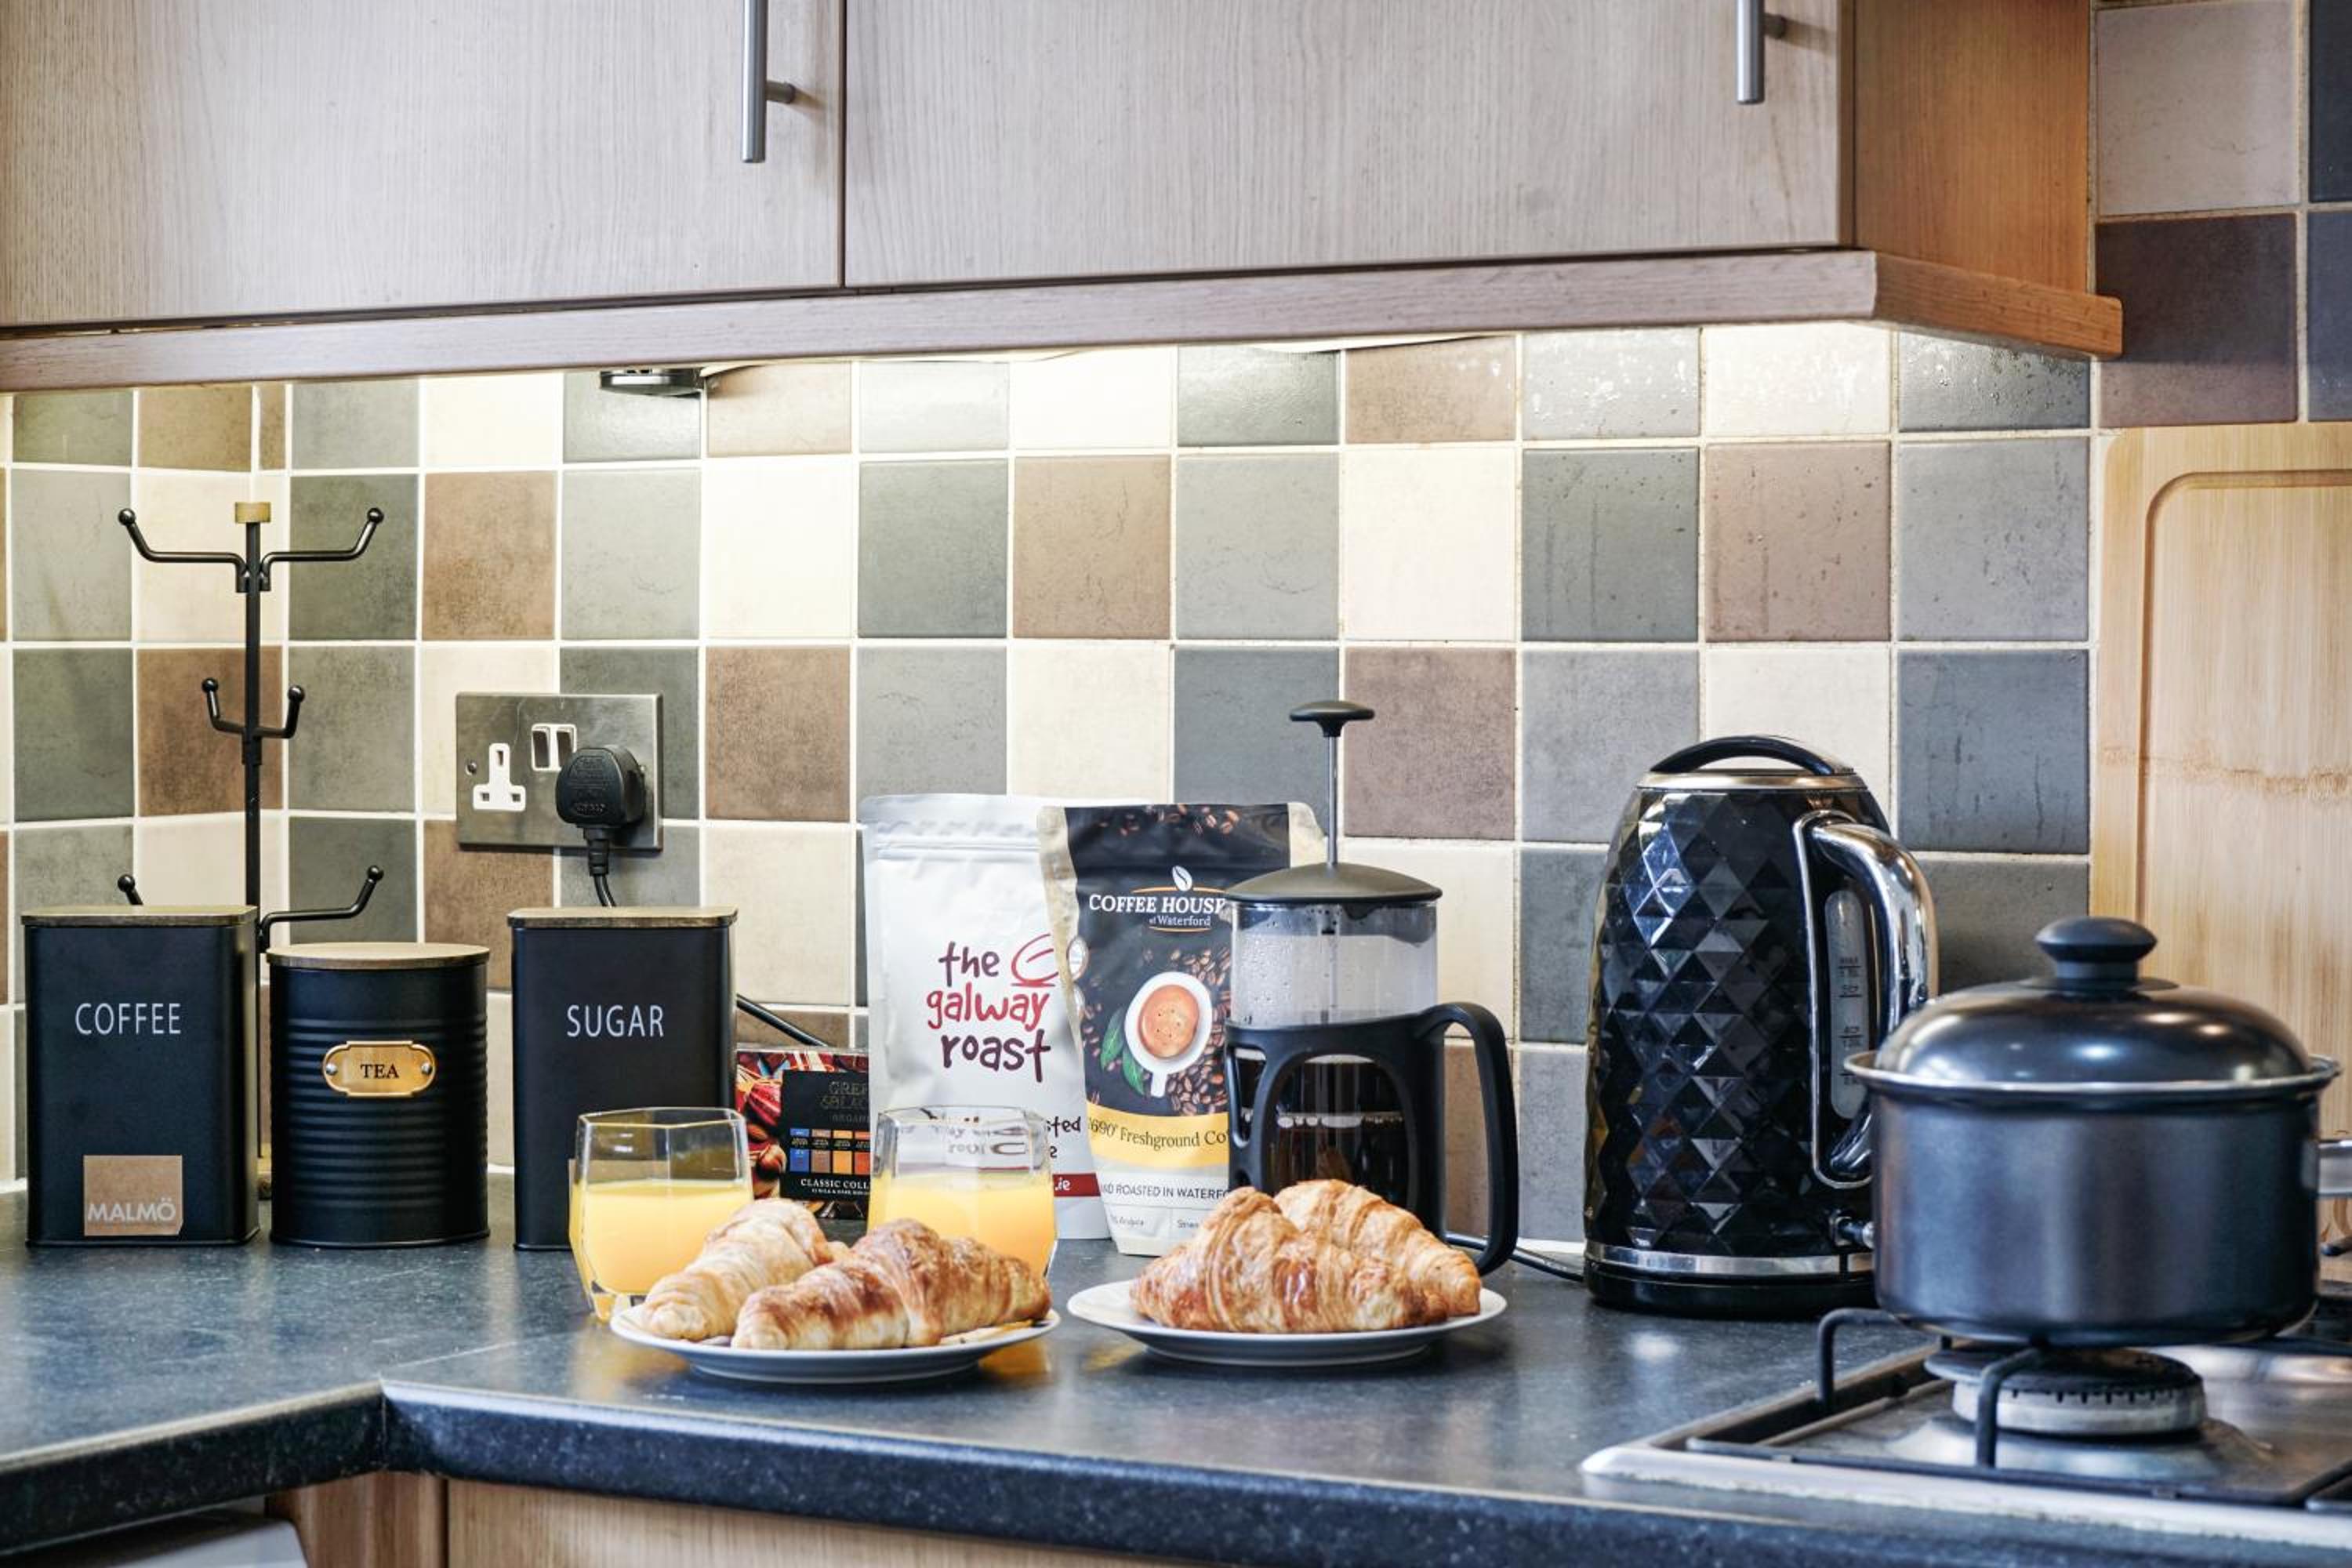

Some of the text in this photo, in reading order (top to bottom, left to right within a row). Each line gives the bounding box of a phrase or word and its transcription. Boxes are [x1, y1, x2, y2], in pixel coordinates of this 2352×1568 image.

[1089, 893, 1157, 913] COFFEE
[1158, 915, 1211, 927] Waterford
[938, 941, 1000, 988] the
[75, 1003, 181, 1035] COFFEE
[927, 982, 1051, 1033] galway
[566, 1004, 665, 1037] SUGAR
[941, 1028, 1051, 1083] roast
[360, 1063, 400, 1079] TEA
[1120, 1127, 1200, 1151] Freshground
[1203, 1130, 1229, 1145] Co
[800, 1178, 841, 1189] CLASSIC
[1116, 1184, 1160, 1197] ROASTED
[1163, 1187, 1174, 1196] IN
[87, 1196, 176, 1222] MALMÖ
